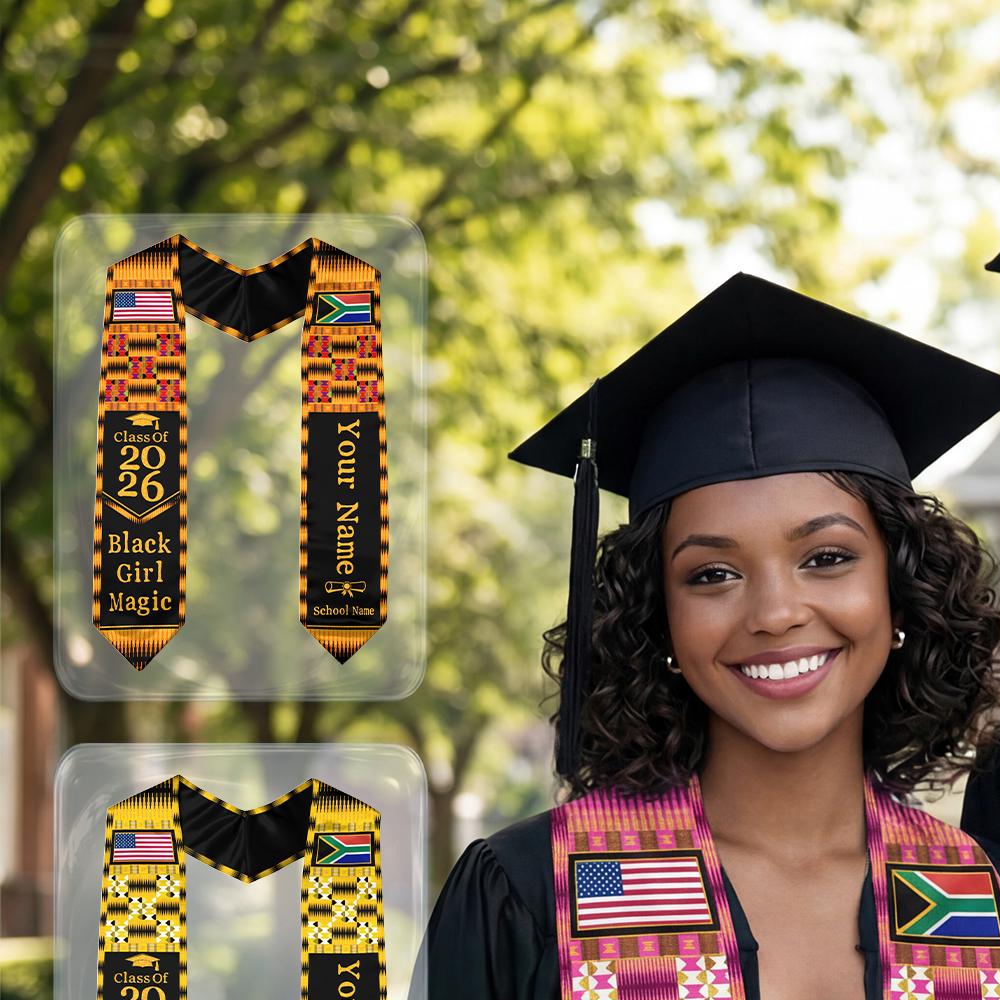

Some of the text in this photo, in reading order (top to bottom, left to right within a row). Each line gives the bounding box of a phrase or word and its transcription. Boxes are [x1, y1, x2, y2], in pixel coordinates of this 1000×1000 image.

[120, 445, 166, 470] 20
[118, 470, 164, 502] 26
[337, 419, 360, 574] Your Name
[109, 531, 171, 553] Black
[117, 560, 163, 583] Girl
[109, 590, 171, 616] Magic
[314, 605, 374, 615] School Name
